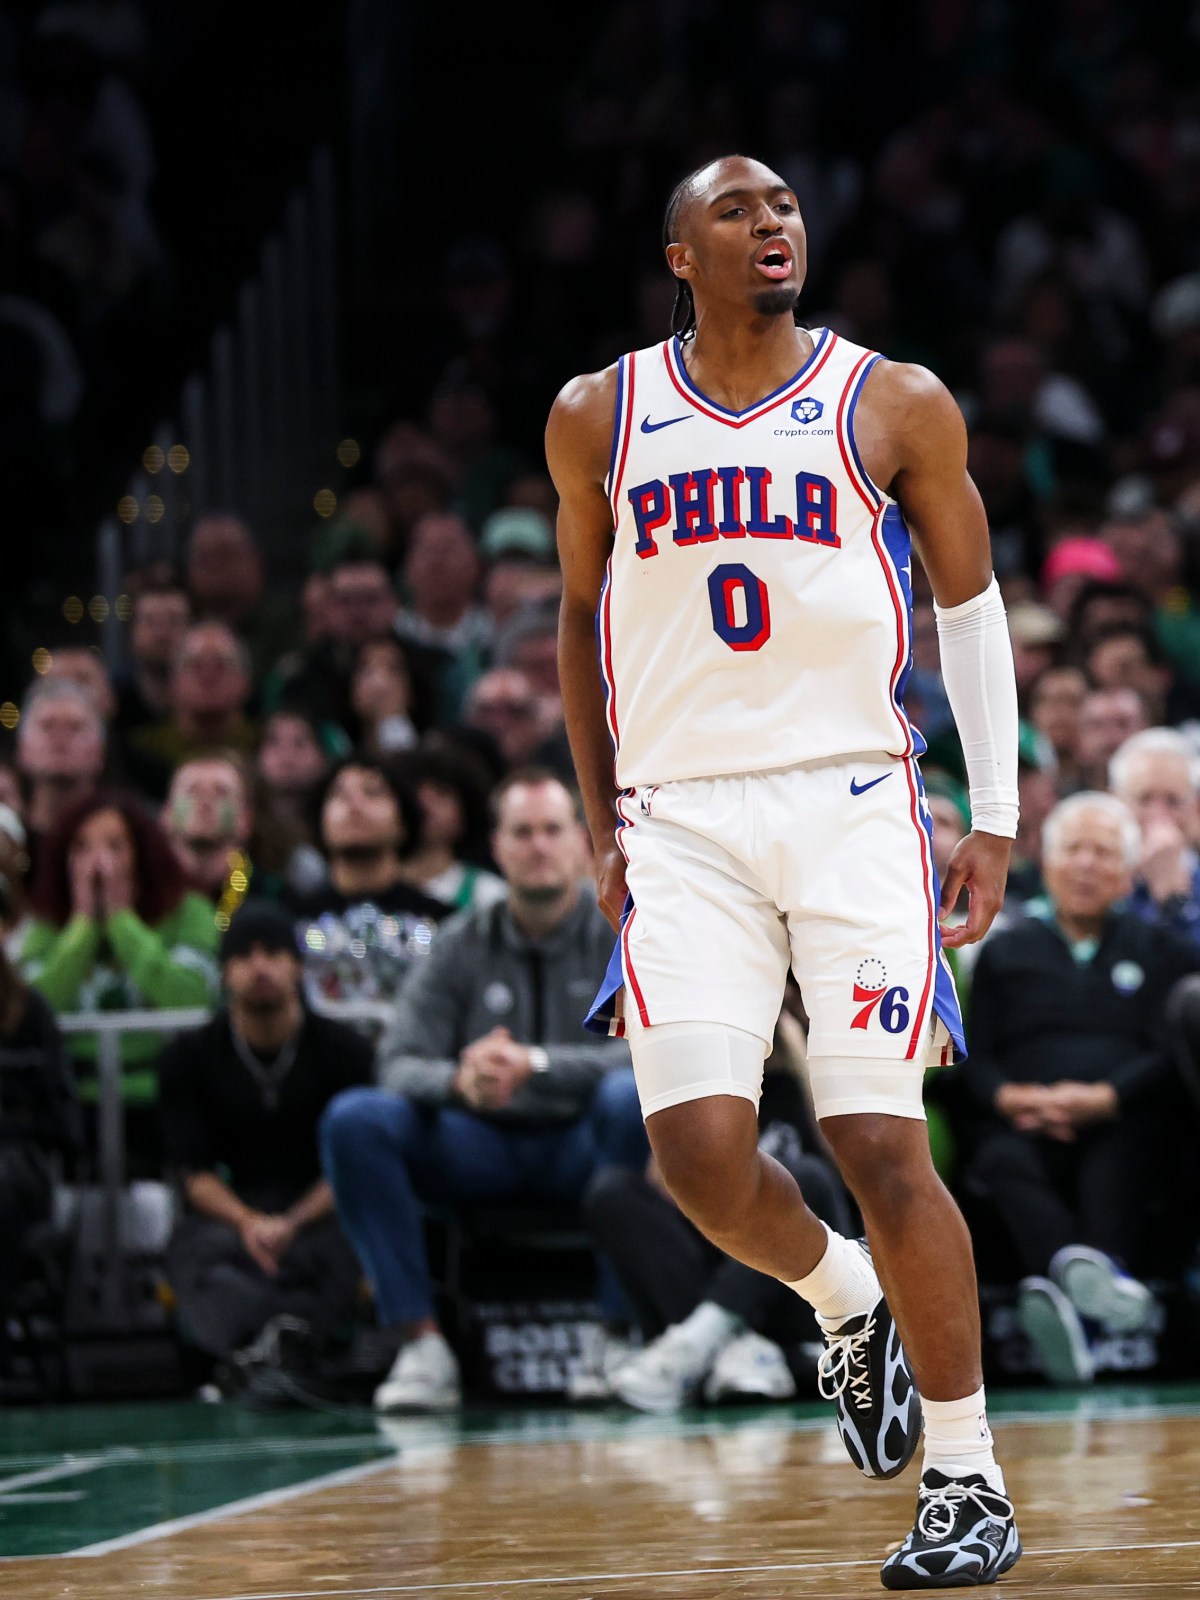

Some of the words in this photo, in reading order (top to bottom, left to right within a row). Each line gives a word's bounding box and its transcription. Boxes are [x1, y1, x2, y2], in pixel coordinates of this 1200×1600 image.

[773, 428, 834, 437] crypto.com
[627, 465, 842, 560] PHILA
[707, 562, 771, 652] 0
[850, 982, 910, 1034] 76
